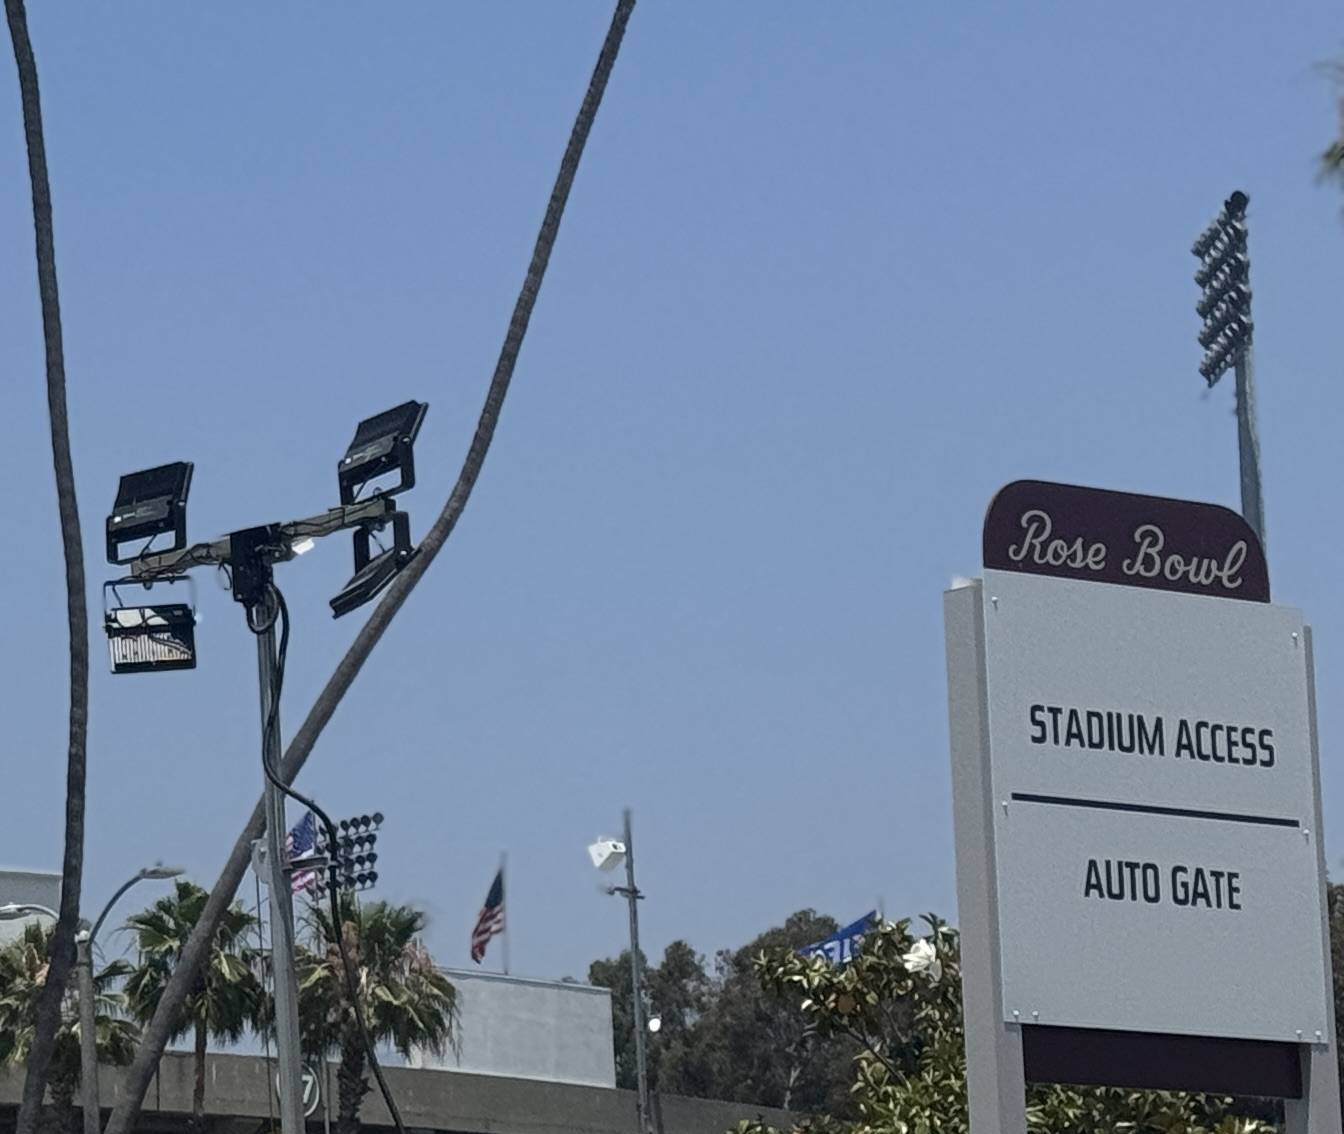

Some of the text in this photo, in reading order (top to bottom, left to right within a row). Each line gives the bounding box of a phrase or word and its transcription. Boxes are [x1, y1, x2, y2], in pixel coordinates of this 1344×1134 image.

[1009, 510, 1249, 589] Rose Bowl
[1030, 704, 1276, 768] STADIUM ACCESS
[1084, 858, 1242, 911] AUTO GATE
